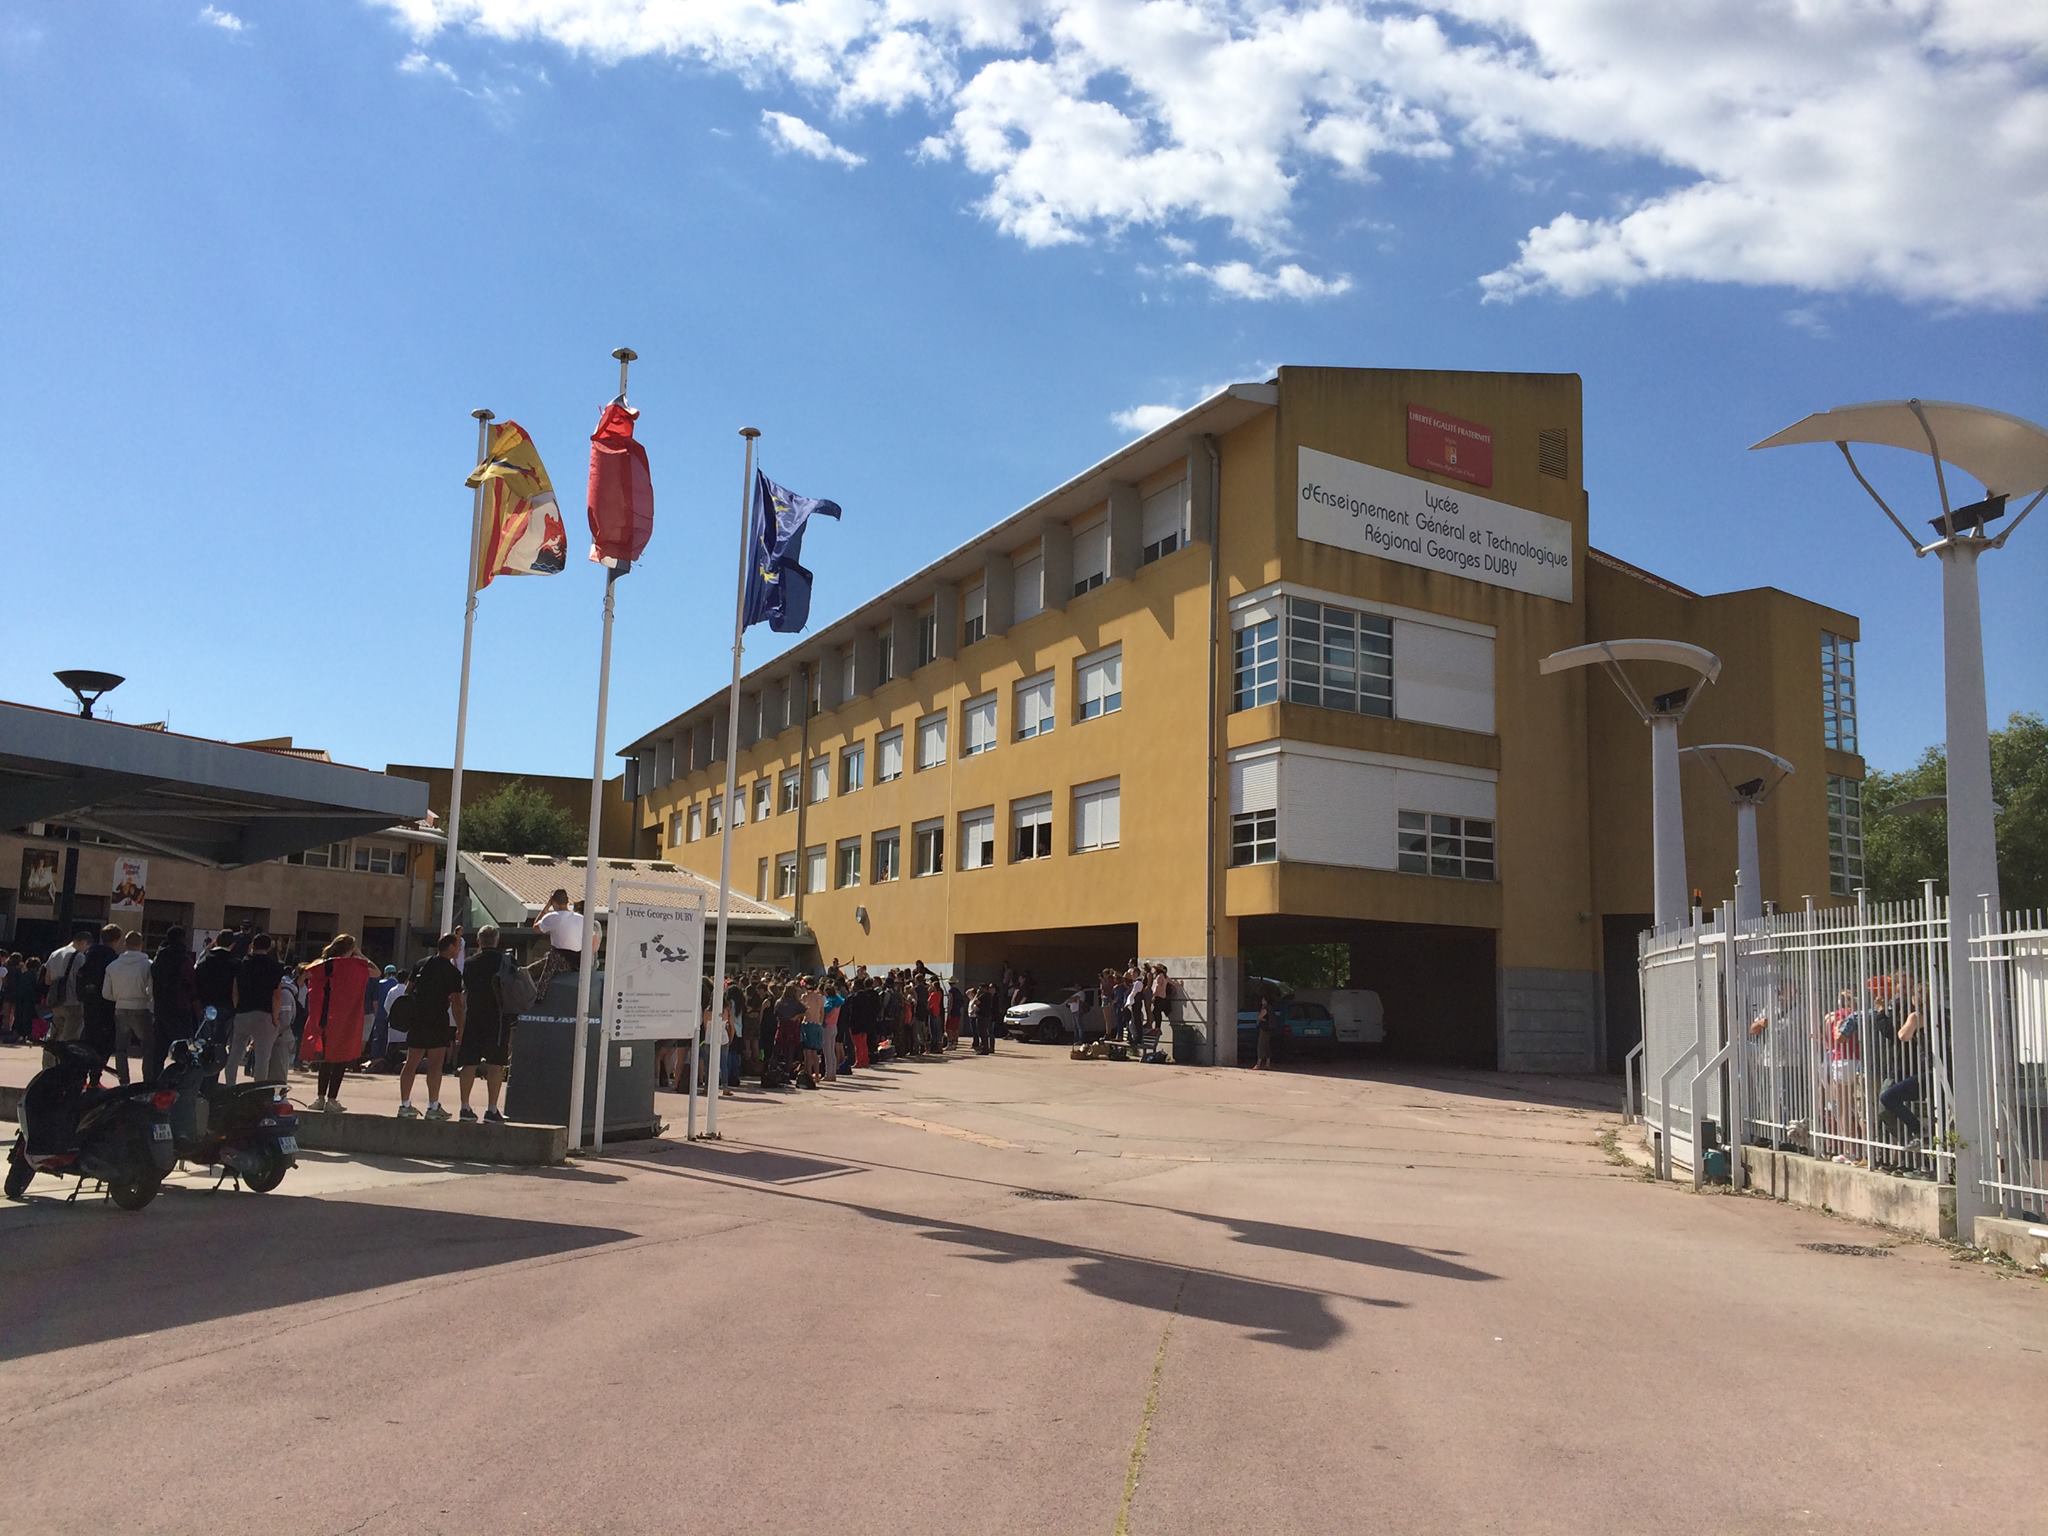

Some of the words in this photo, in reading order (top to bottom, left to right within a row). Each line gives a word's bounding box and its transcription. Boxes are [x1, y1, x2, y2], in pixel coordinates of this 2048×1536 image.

[1425, 489, 1459, 514] Lycée
[1302, 483, 1409, 527] d'Enseignement
[1416, 512, 1465, 541] Général
[1469, 530, 1482, 545] et
[1485, 530, 1569, 569] Technologique
[1365, 523, 1422, 554] Régional
[1426, 540, 1481, 570] Georges
[1484, 554, 1518, 577] DUBY
[626, 907, 646, 920] Lycée
[646, 909, 674, 921] Georges
